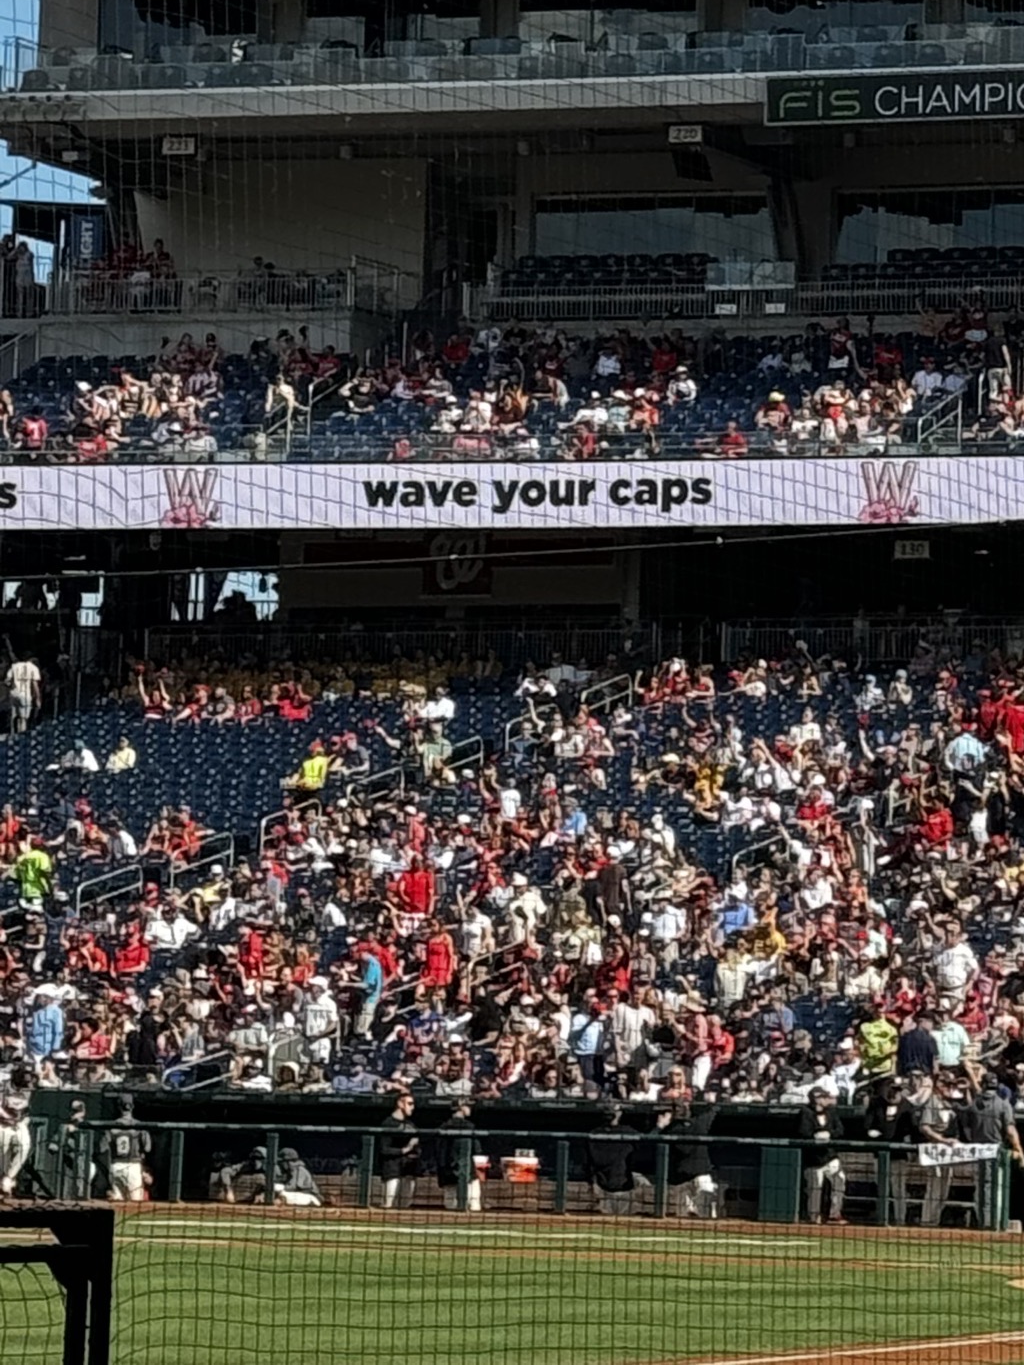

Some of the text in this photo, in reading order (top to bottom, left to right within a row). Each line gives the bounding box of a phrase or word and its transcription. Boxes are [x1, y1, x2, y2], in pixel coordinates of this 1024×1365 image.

[362, 477, 713, 514] wave your caps
